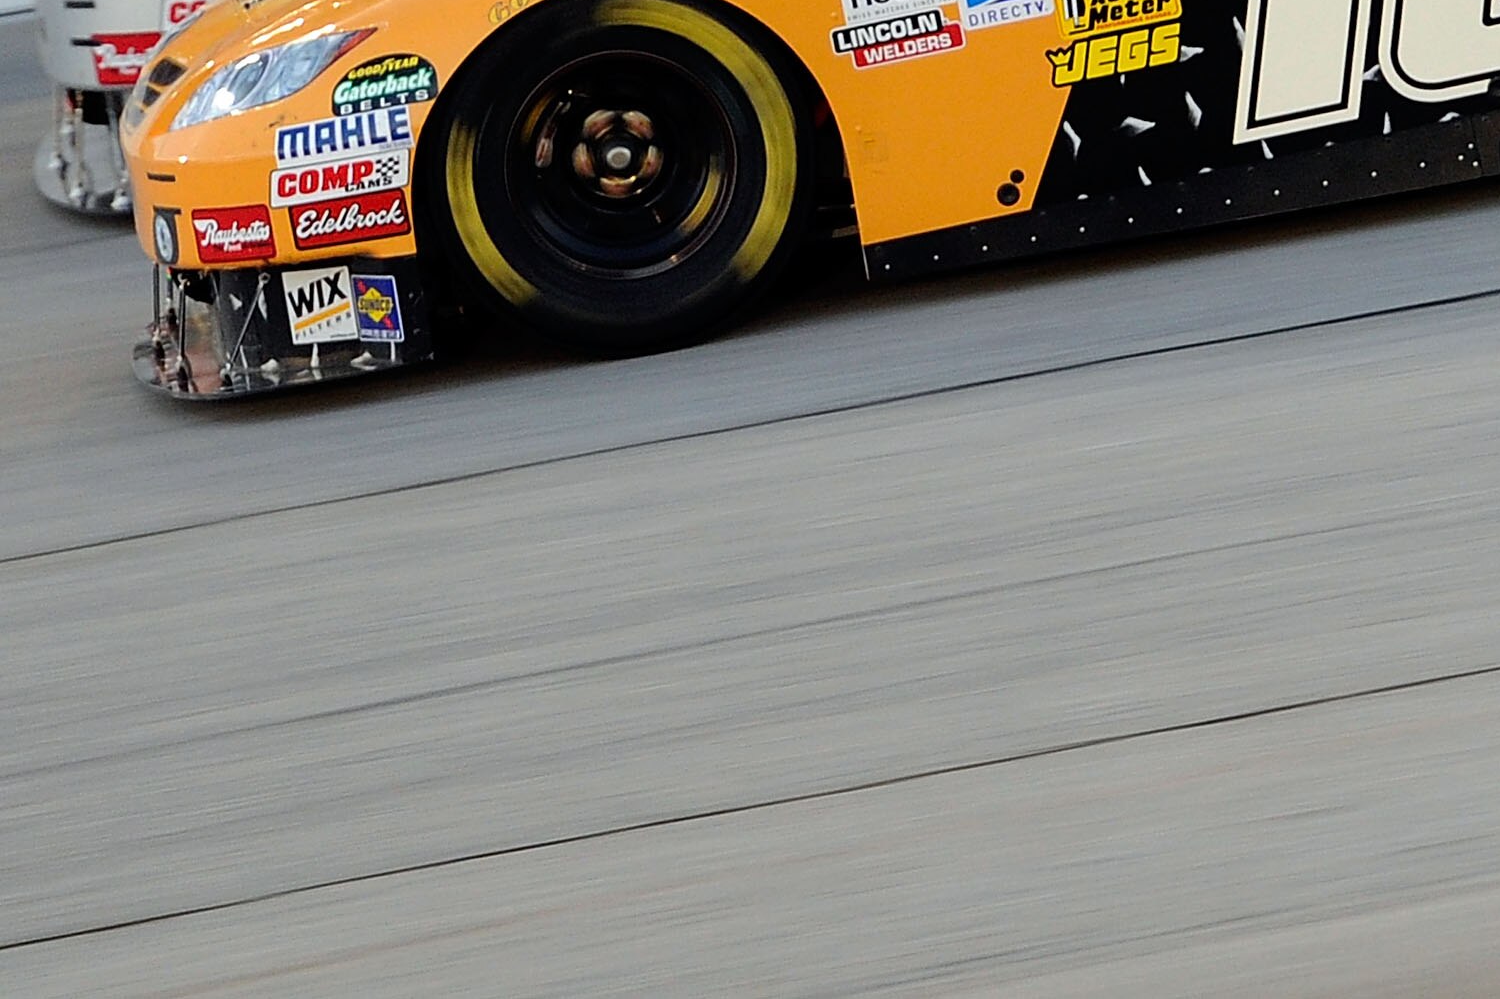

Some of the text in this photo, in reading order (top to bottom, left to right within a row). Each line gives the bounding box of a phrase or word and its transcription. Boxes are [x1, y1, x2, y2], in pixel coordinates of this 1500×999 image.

[836, 12, 940, 51] LINCOLN
[968, 0, 1045, 28] DIRECTV
[863, 32, 953, 65] WELDERS
[1050, 22, 1181, 86] JEGS
[333, 67, 434, 105] Gatorback
[340, 89, 429, 116] BELTS
[277, 107, 411, 161] MAHLE
[277, 160, 375, 198] COMP
[344, 175, 393, 193] CAMS
[296, 199, 405, 240] Edelbrock
[287, 268, 348, 319] WIX
[294, 310, 352, 341] FILTERS
